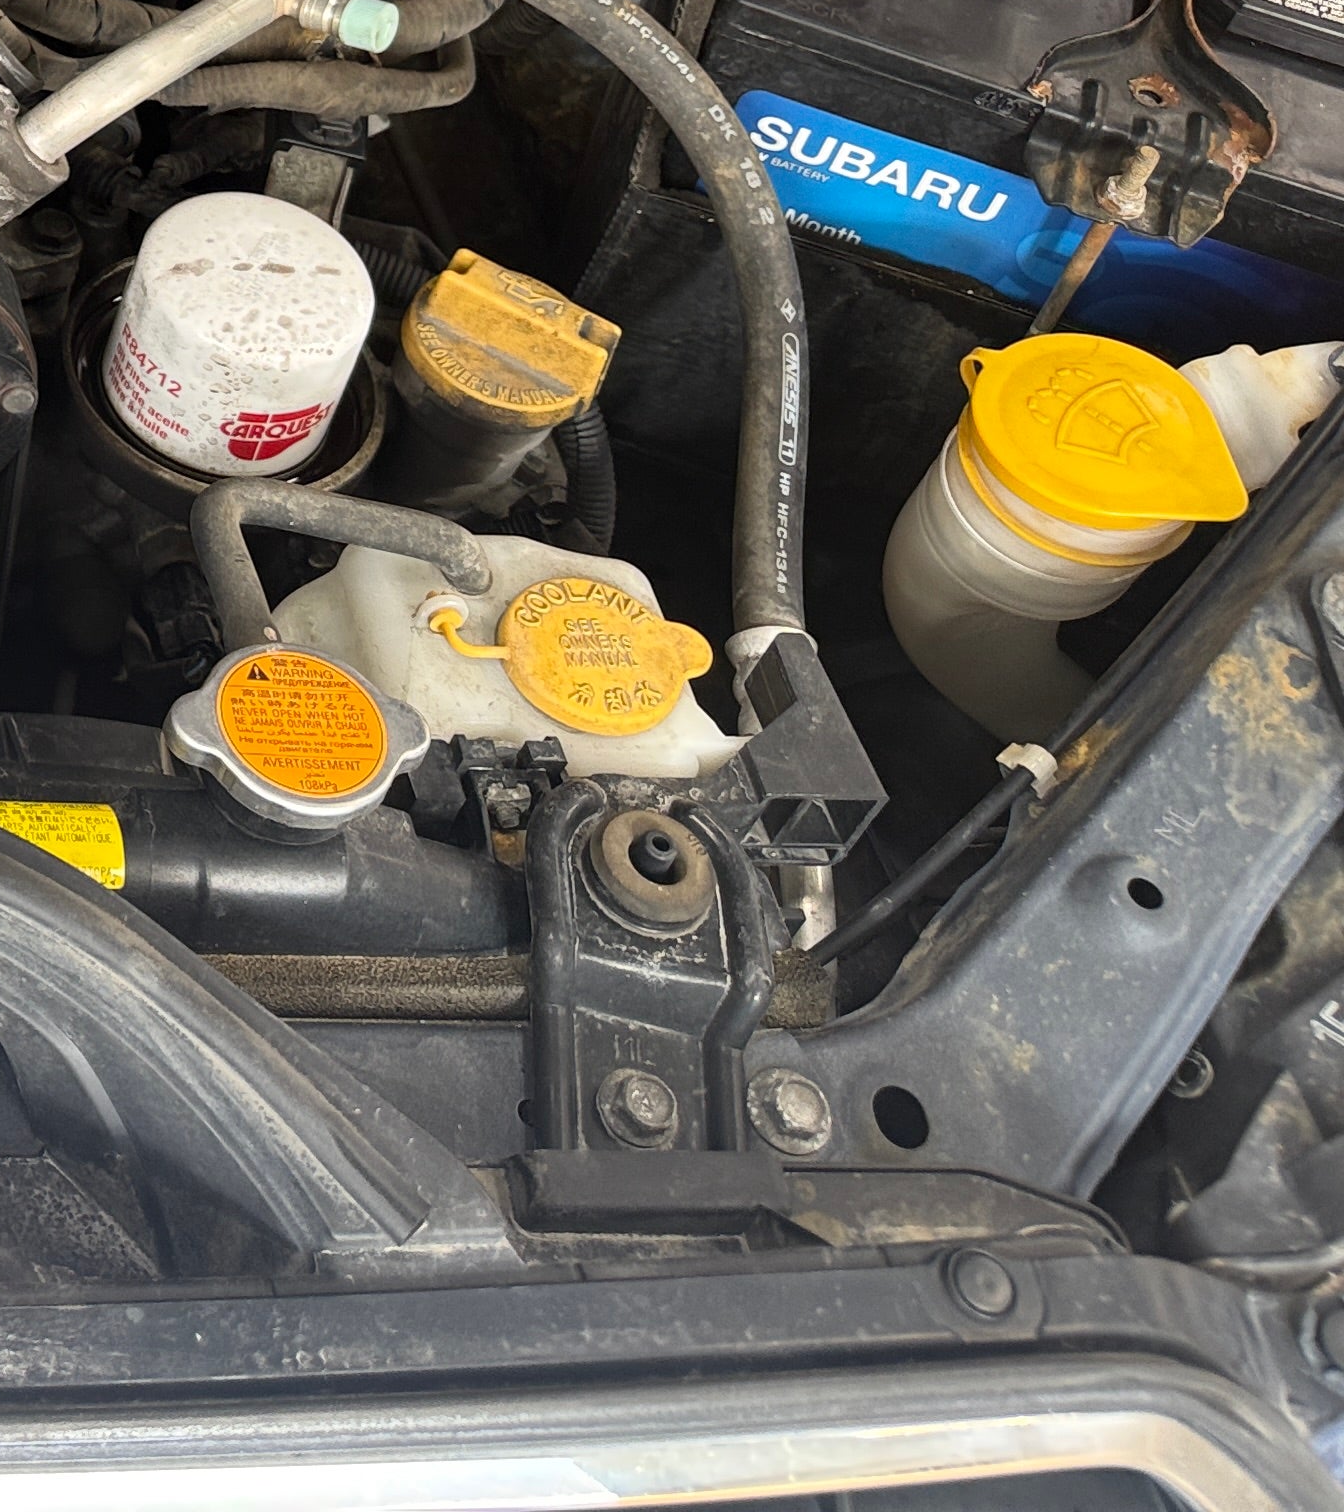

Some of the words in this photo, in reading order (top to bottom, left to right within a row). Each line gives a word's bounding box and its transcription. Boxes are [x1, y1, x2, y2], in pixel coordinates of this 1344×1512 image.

[617, 7, 697, 84] HFC-134a
[708, 104, 738, 142] DK
[749, 115, 1010, 223] SUBARU
[770, 156, 832, 184] BATTERY
[784, 207, 863, 245] Month
[115, 342, 126, 364] Oil
[124, 359, 151, 395] Filter
[122, 322, 183, 398] R84712
[417, 321, 439, 352] SEE
[431, 348, 492, 396] OWNER'S
[496, 383, 564, 406] MANUAL
[108, 368, 127, 403] Filtre
[136, 412, 169, 440] huile
[113, 354, 130, 384] Filtro
[131, 389, 145, 408] de
[147, 405, 190, 437] aceite
[219, 400, 335, 439] CARQUEST
[779, 471, 791, 496] HP
[775, 501, 790, 594] HFC-134a
[515, 581, 655, 628] COOLANT
[564, 618, 603, 634] SEE
[559, 634, 633, 651] OWNERS
[269, 667, 334, 680] WARNING
[565, 651, 640, 668] MANUAL
[232, 707, 267, 717] NEVER
[272, 709, 302, 719] OPEN
[306, 711, 339, 721] WHEN
[343, 712, 366, 722] HOT
[234, 717, 247, 725] NE
[251, 718, 284, 728] JAMAIS
[287, 719, 322, 729] OUVRIR
[336, 722, 368, 731] CHAUD
[262, 756, 362, 771] AVERTISSEMENT
[299, 779, 338, 792] 108kPa
[29, 823, 96, 833] AUTOMATICALLY
[56, 833, 113, 843] AUTOMATIQUE
